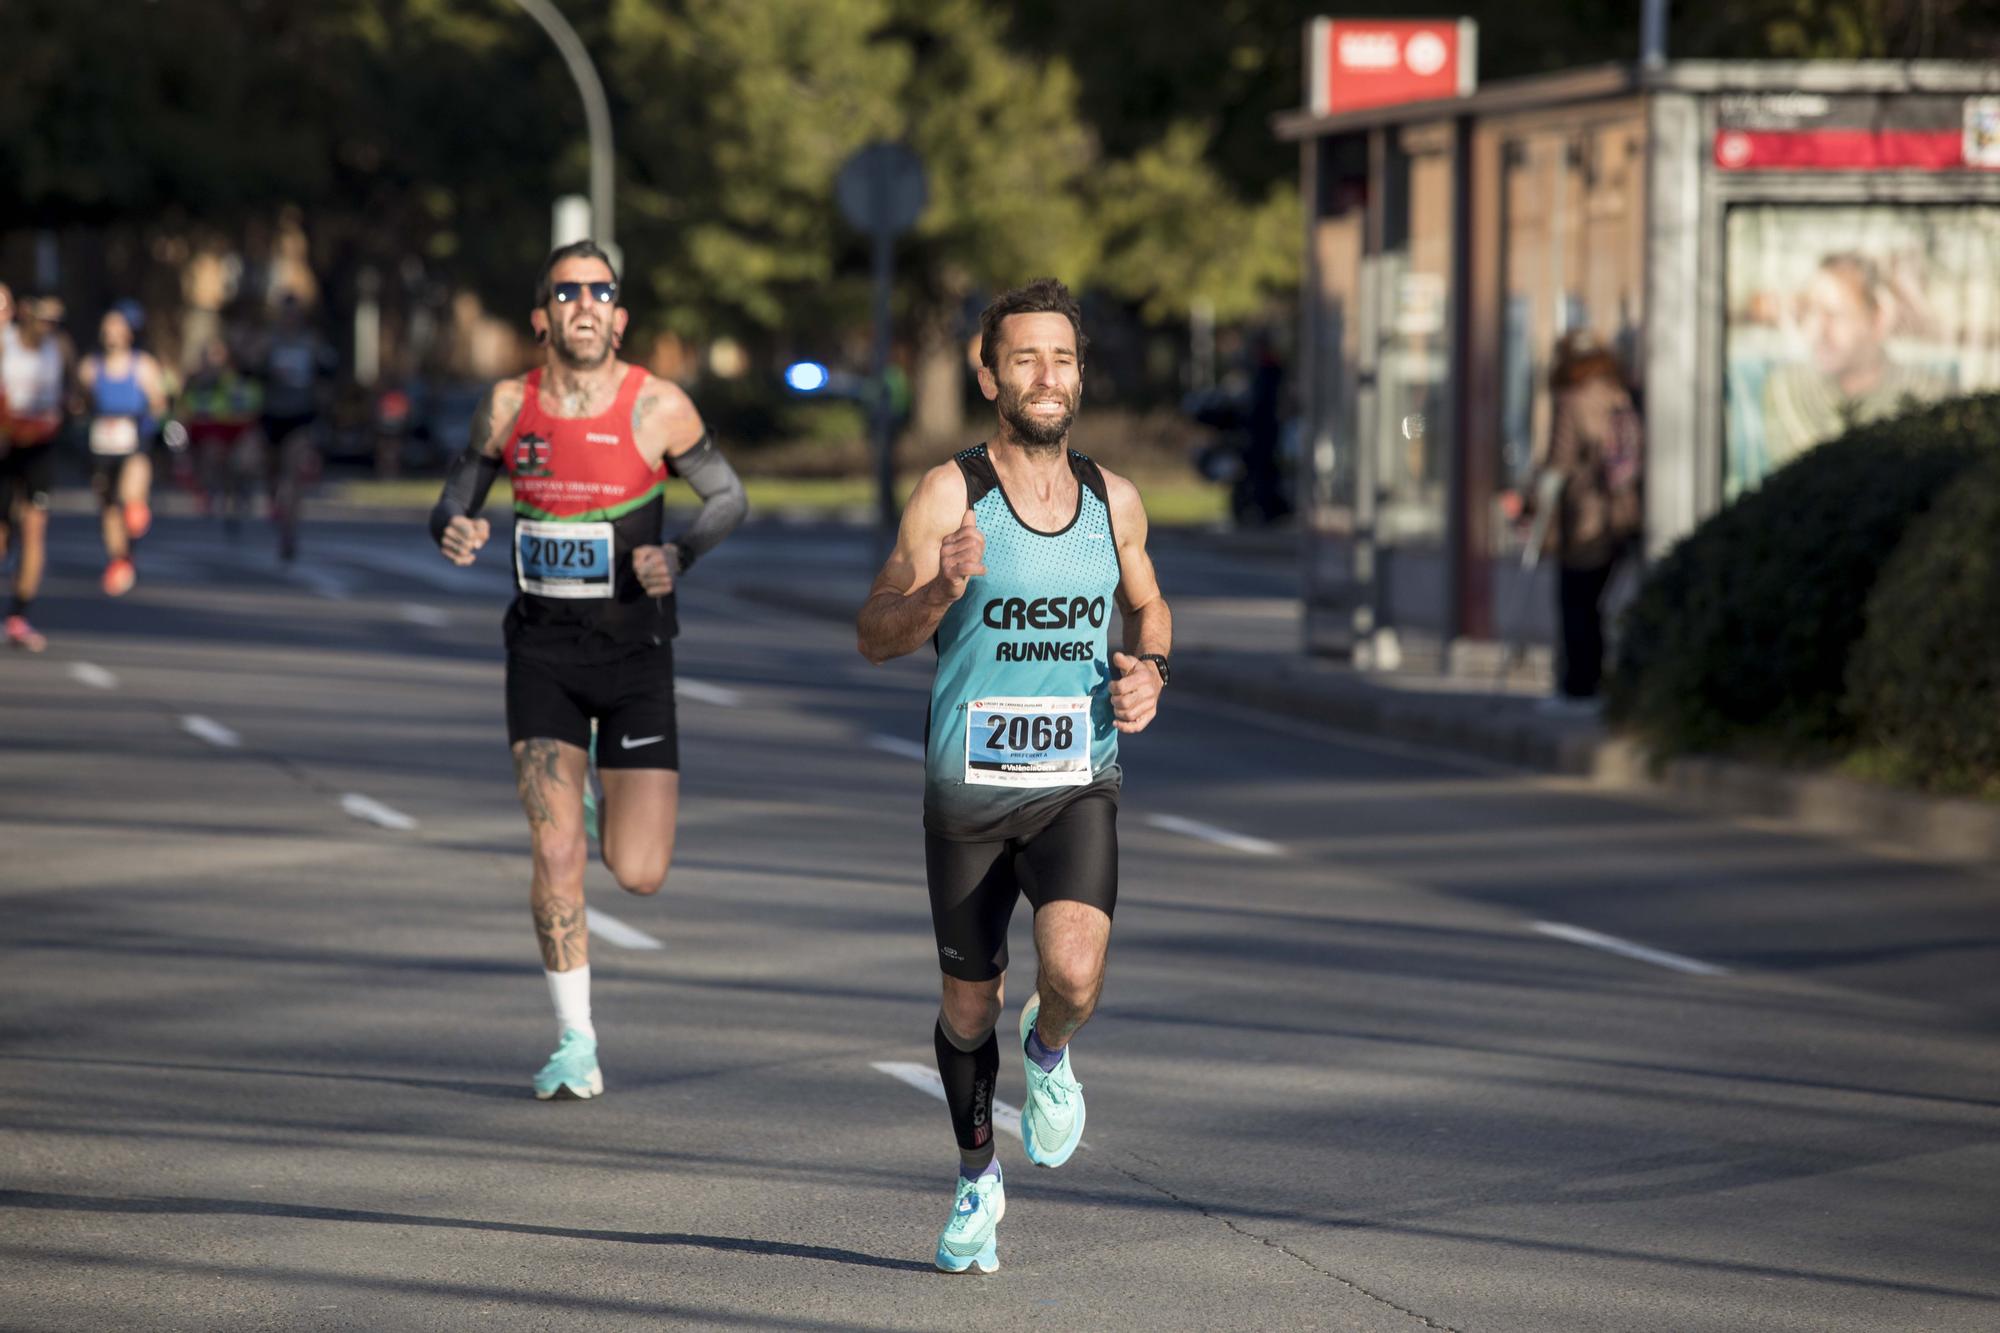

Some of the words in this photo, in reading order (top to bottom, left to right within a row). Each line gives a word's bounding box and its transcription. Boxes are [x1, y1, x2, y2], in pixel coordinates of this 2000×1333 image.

[528, 537, 595, 568] 2025
[983, 595, 1105, 630] CRESPO
[996, 640, 1094, 661] RUNNERS
[986, 714, 1073, 751] 2068
